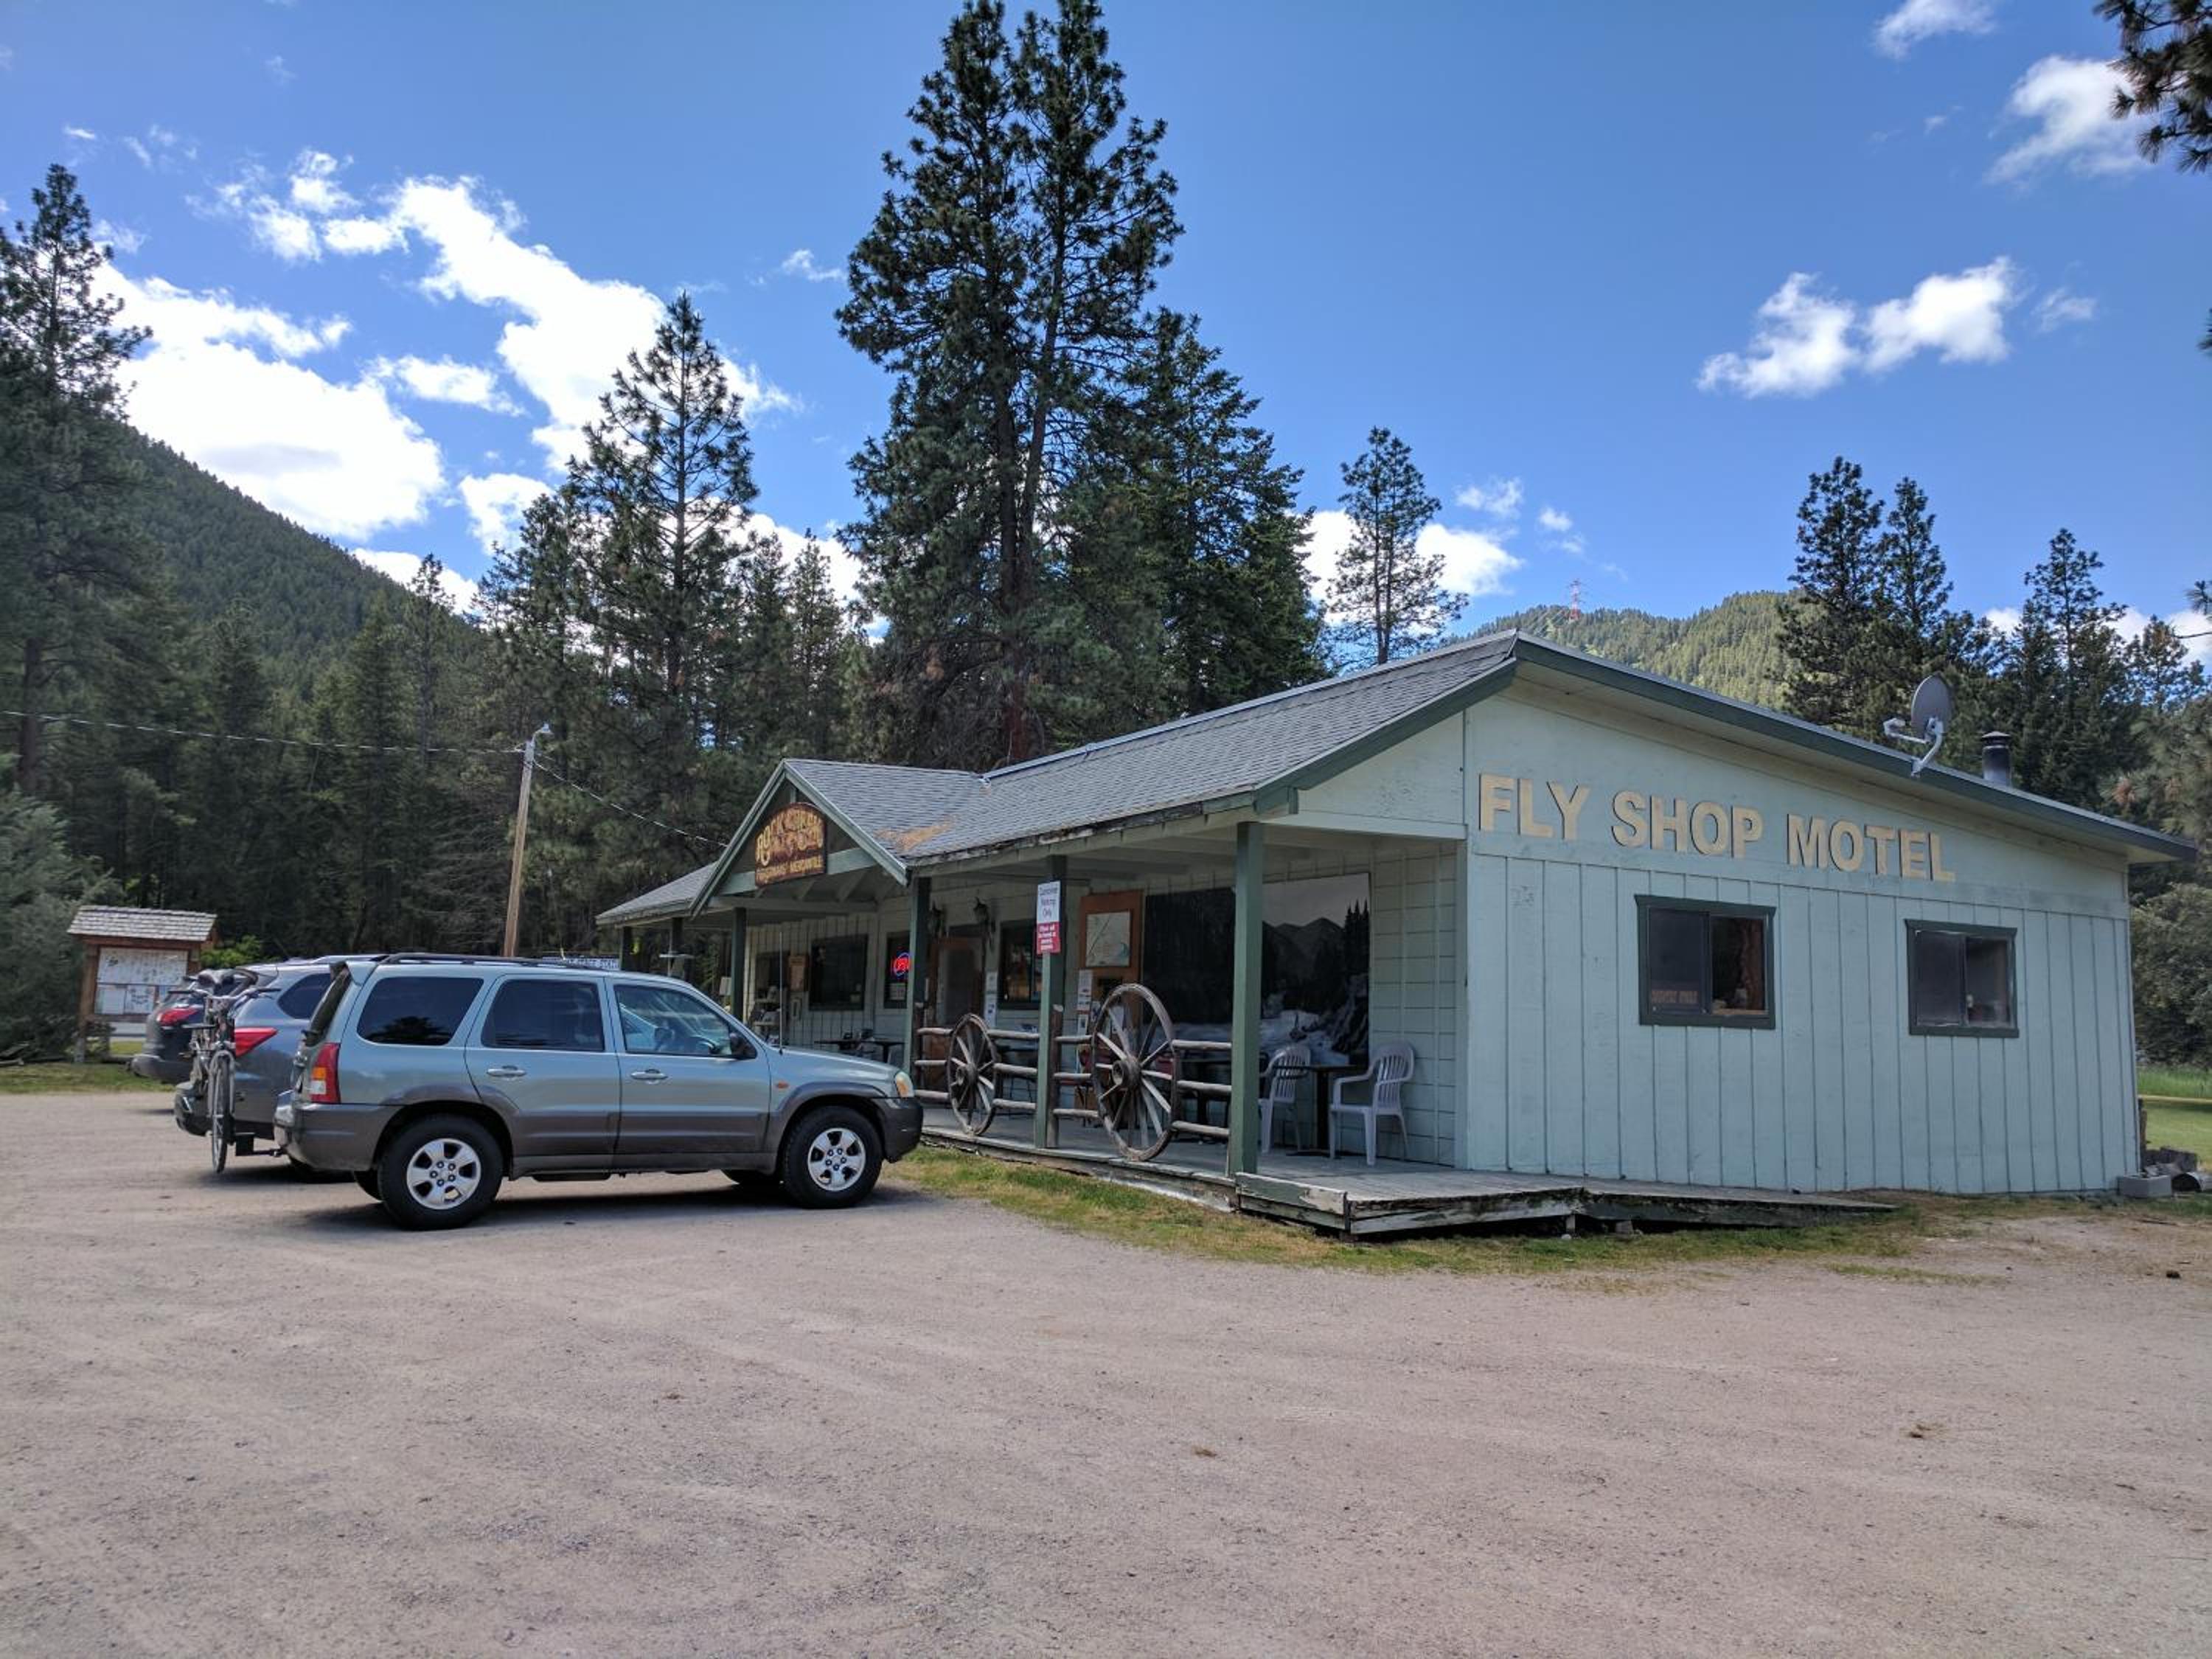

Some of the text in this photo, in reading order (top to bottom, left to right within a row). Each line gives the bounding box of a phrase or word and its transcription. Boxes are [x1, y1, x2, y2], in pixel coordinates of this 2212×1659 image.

[1478, 773, 1956, 883] FLY SHOP MOTEL
